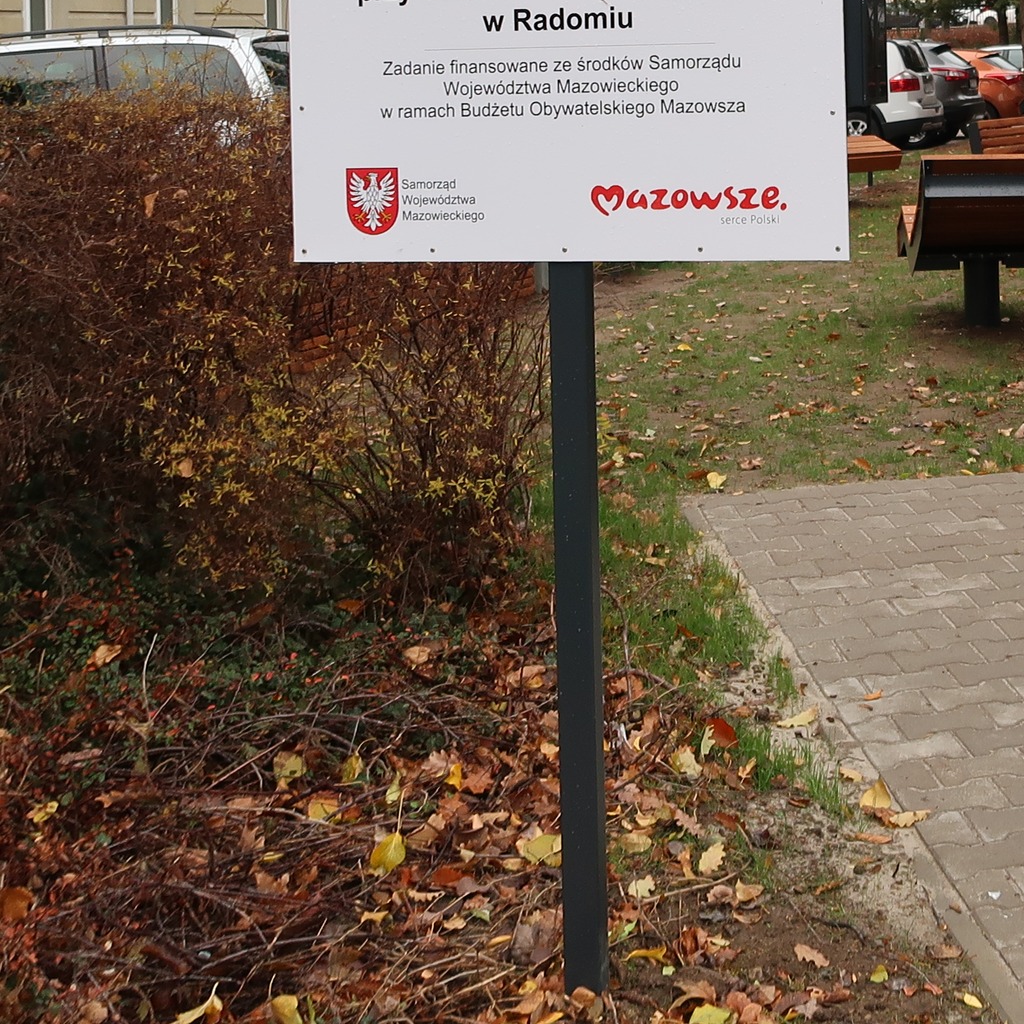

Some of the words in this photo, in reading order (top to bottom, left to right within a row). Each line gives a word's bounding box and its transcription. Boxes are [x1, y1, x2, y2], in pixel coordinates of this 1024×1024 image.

[482, 14, 505, 32] w
[514, 6, 632, 31] Radomiu
[383, 61, 445, 75] Zadanie
[450, 60, 548, 74] finansowane
[553, 61, 571, 72] ze
[577, 56, 643, 71] środków
[649, 54, 740, 72] Samorządu
[443, 80, 551, 98] Województwa
[557, 78, 678, 95] Mazowieckiego
[379, 107, 394, 118] w
[399, 103, 454, 118] ramach
[461, 103, 523, 117] Budżetu
[530, 100, 654, 119] Obywatelskiego
[661, 99, 745, 113] Mazowsza
[402, 179, 455, 191] Samorząd
[402, 195, 475, 207] Województwa
[403, 211, 484, 223] Mazowieckiego
[720, 216, 747, 224] serce
[750, 214, 780, 224] Polski
